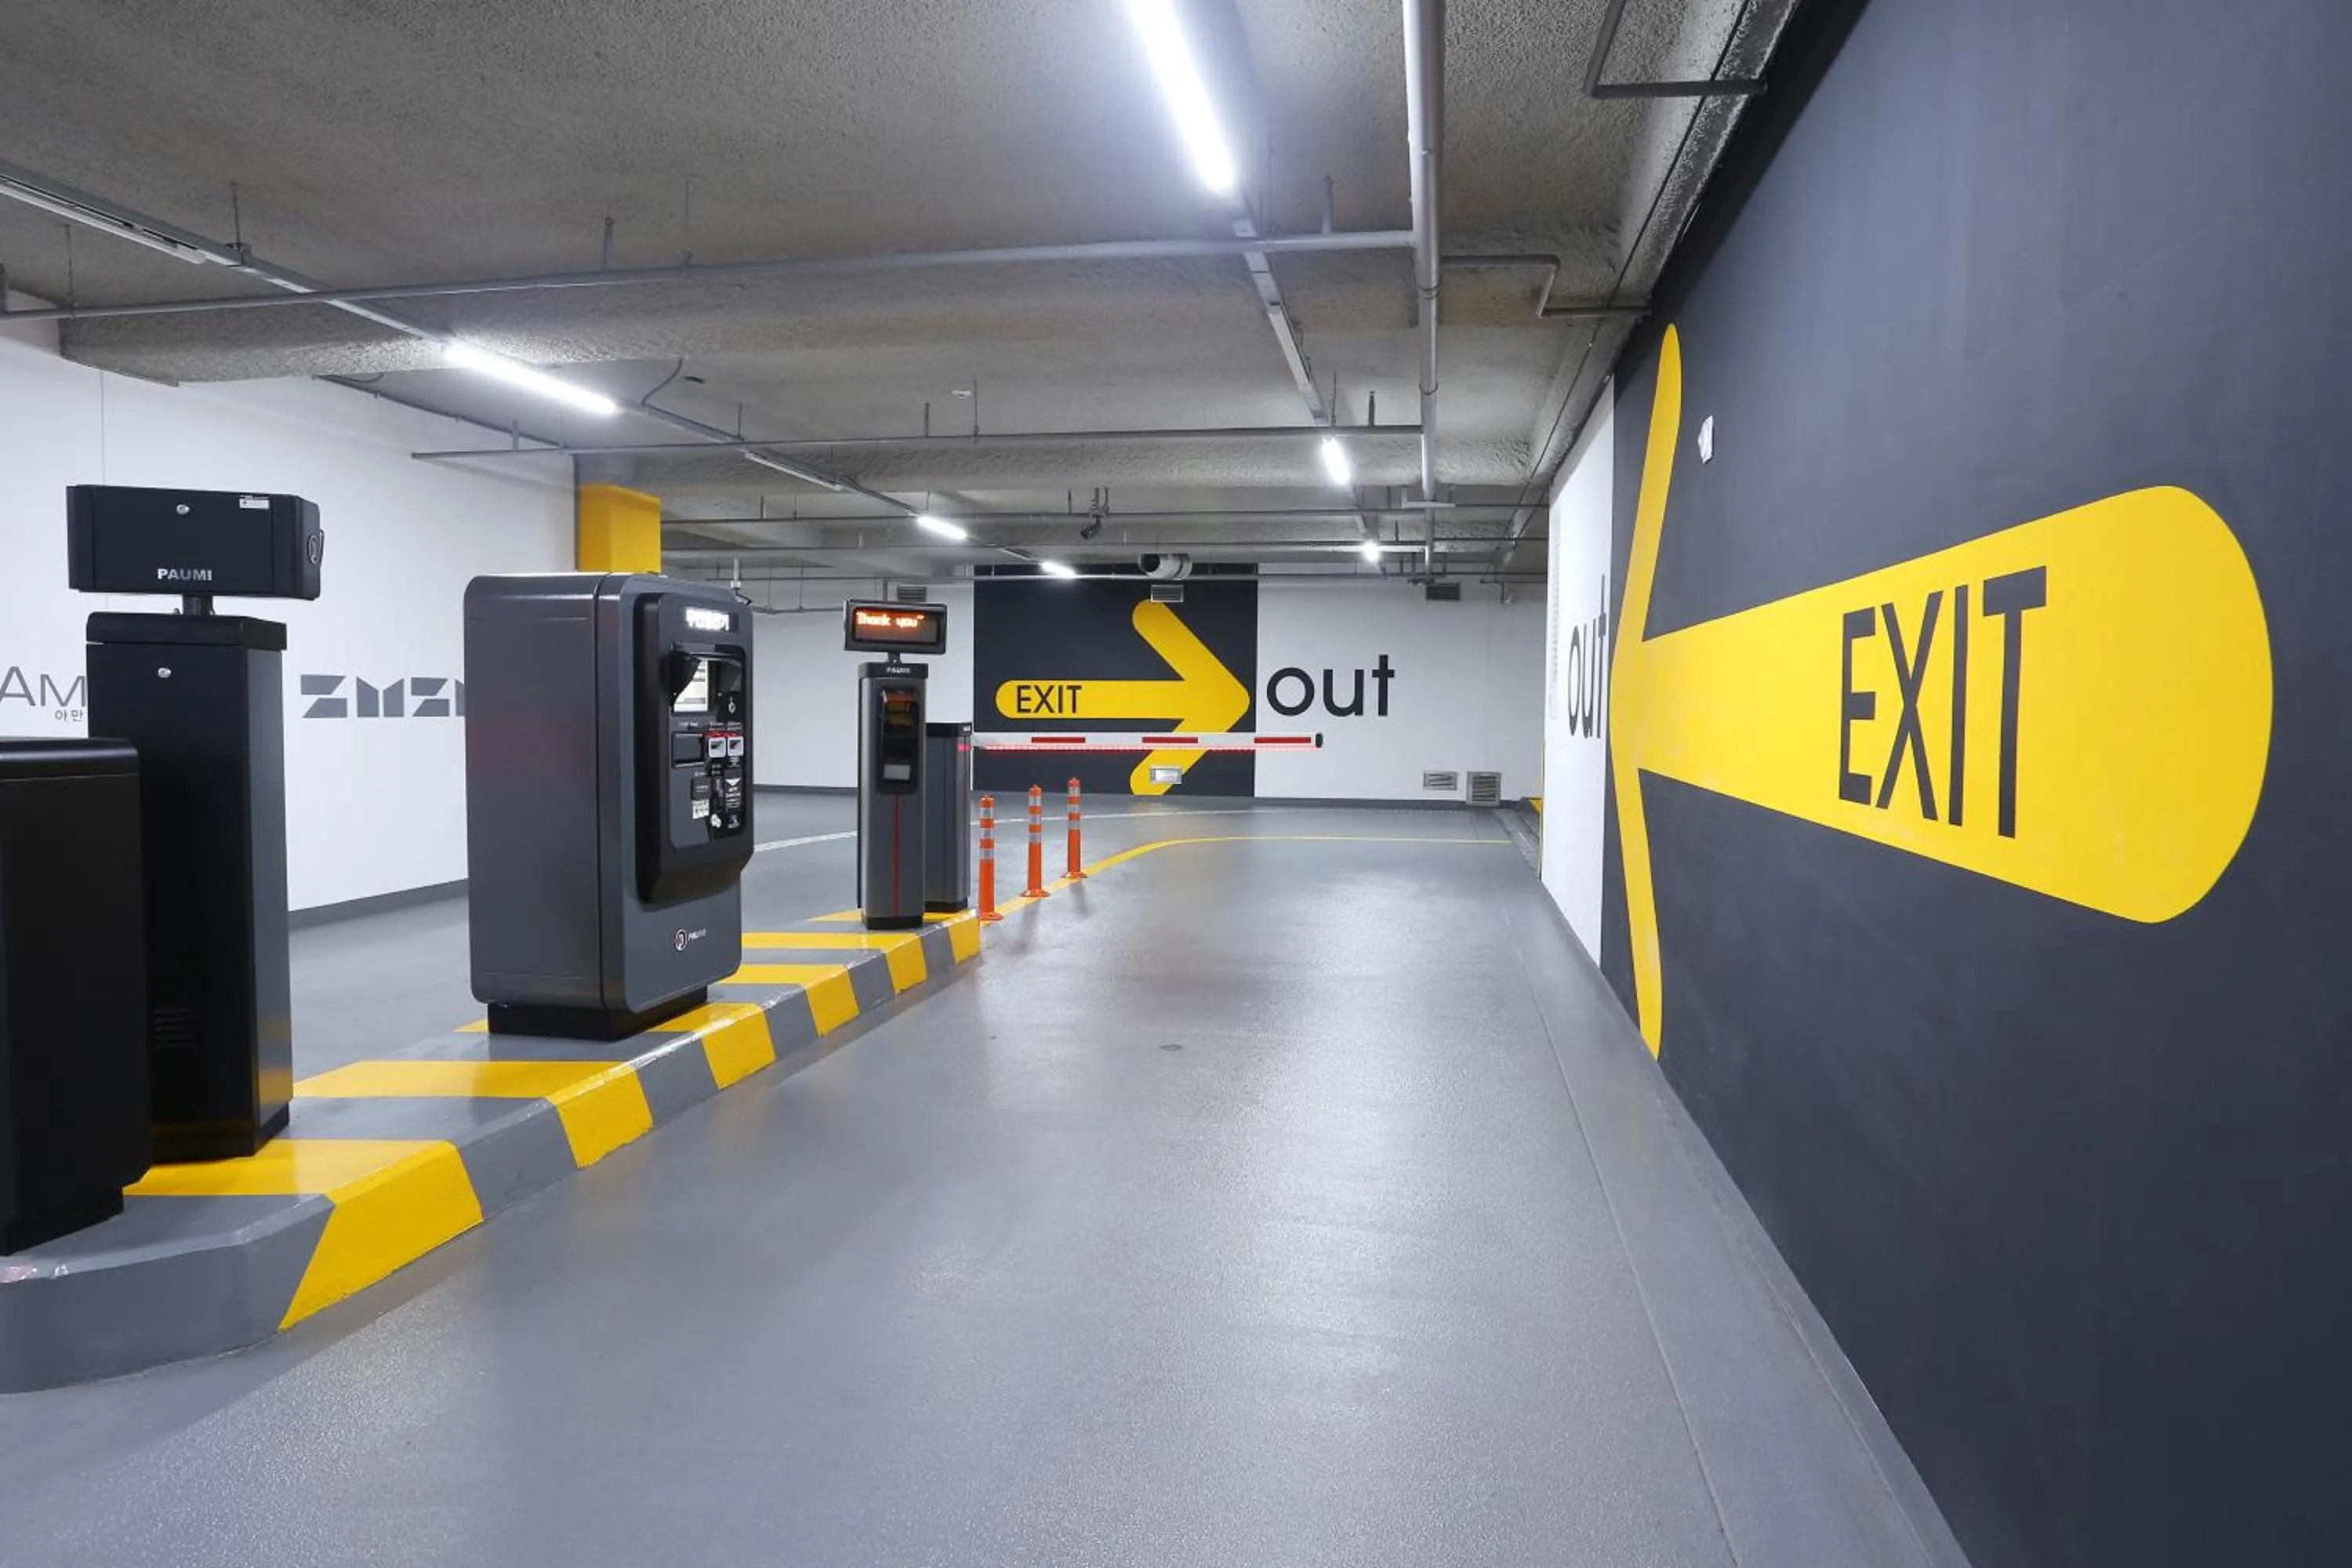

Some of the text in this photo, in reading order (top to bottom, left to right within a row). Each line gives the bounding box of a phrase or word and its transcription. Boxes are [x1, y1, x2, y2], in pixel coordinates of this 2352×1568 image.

[157, 568, 212, 581] PAUMI
[855, 612, 891, 626] Thank
[1567, 573, 1606, 739] out
[1015, 684, 1083, 714] EXIT
[1266, 654, 1396, 717] out
[1838, 564, 2047, 839] EXIT
